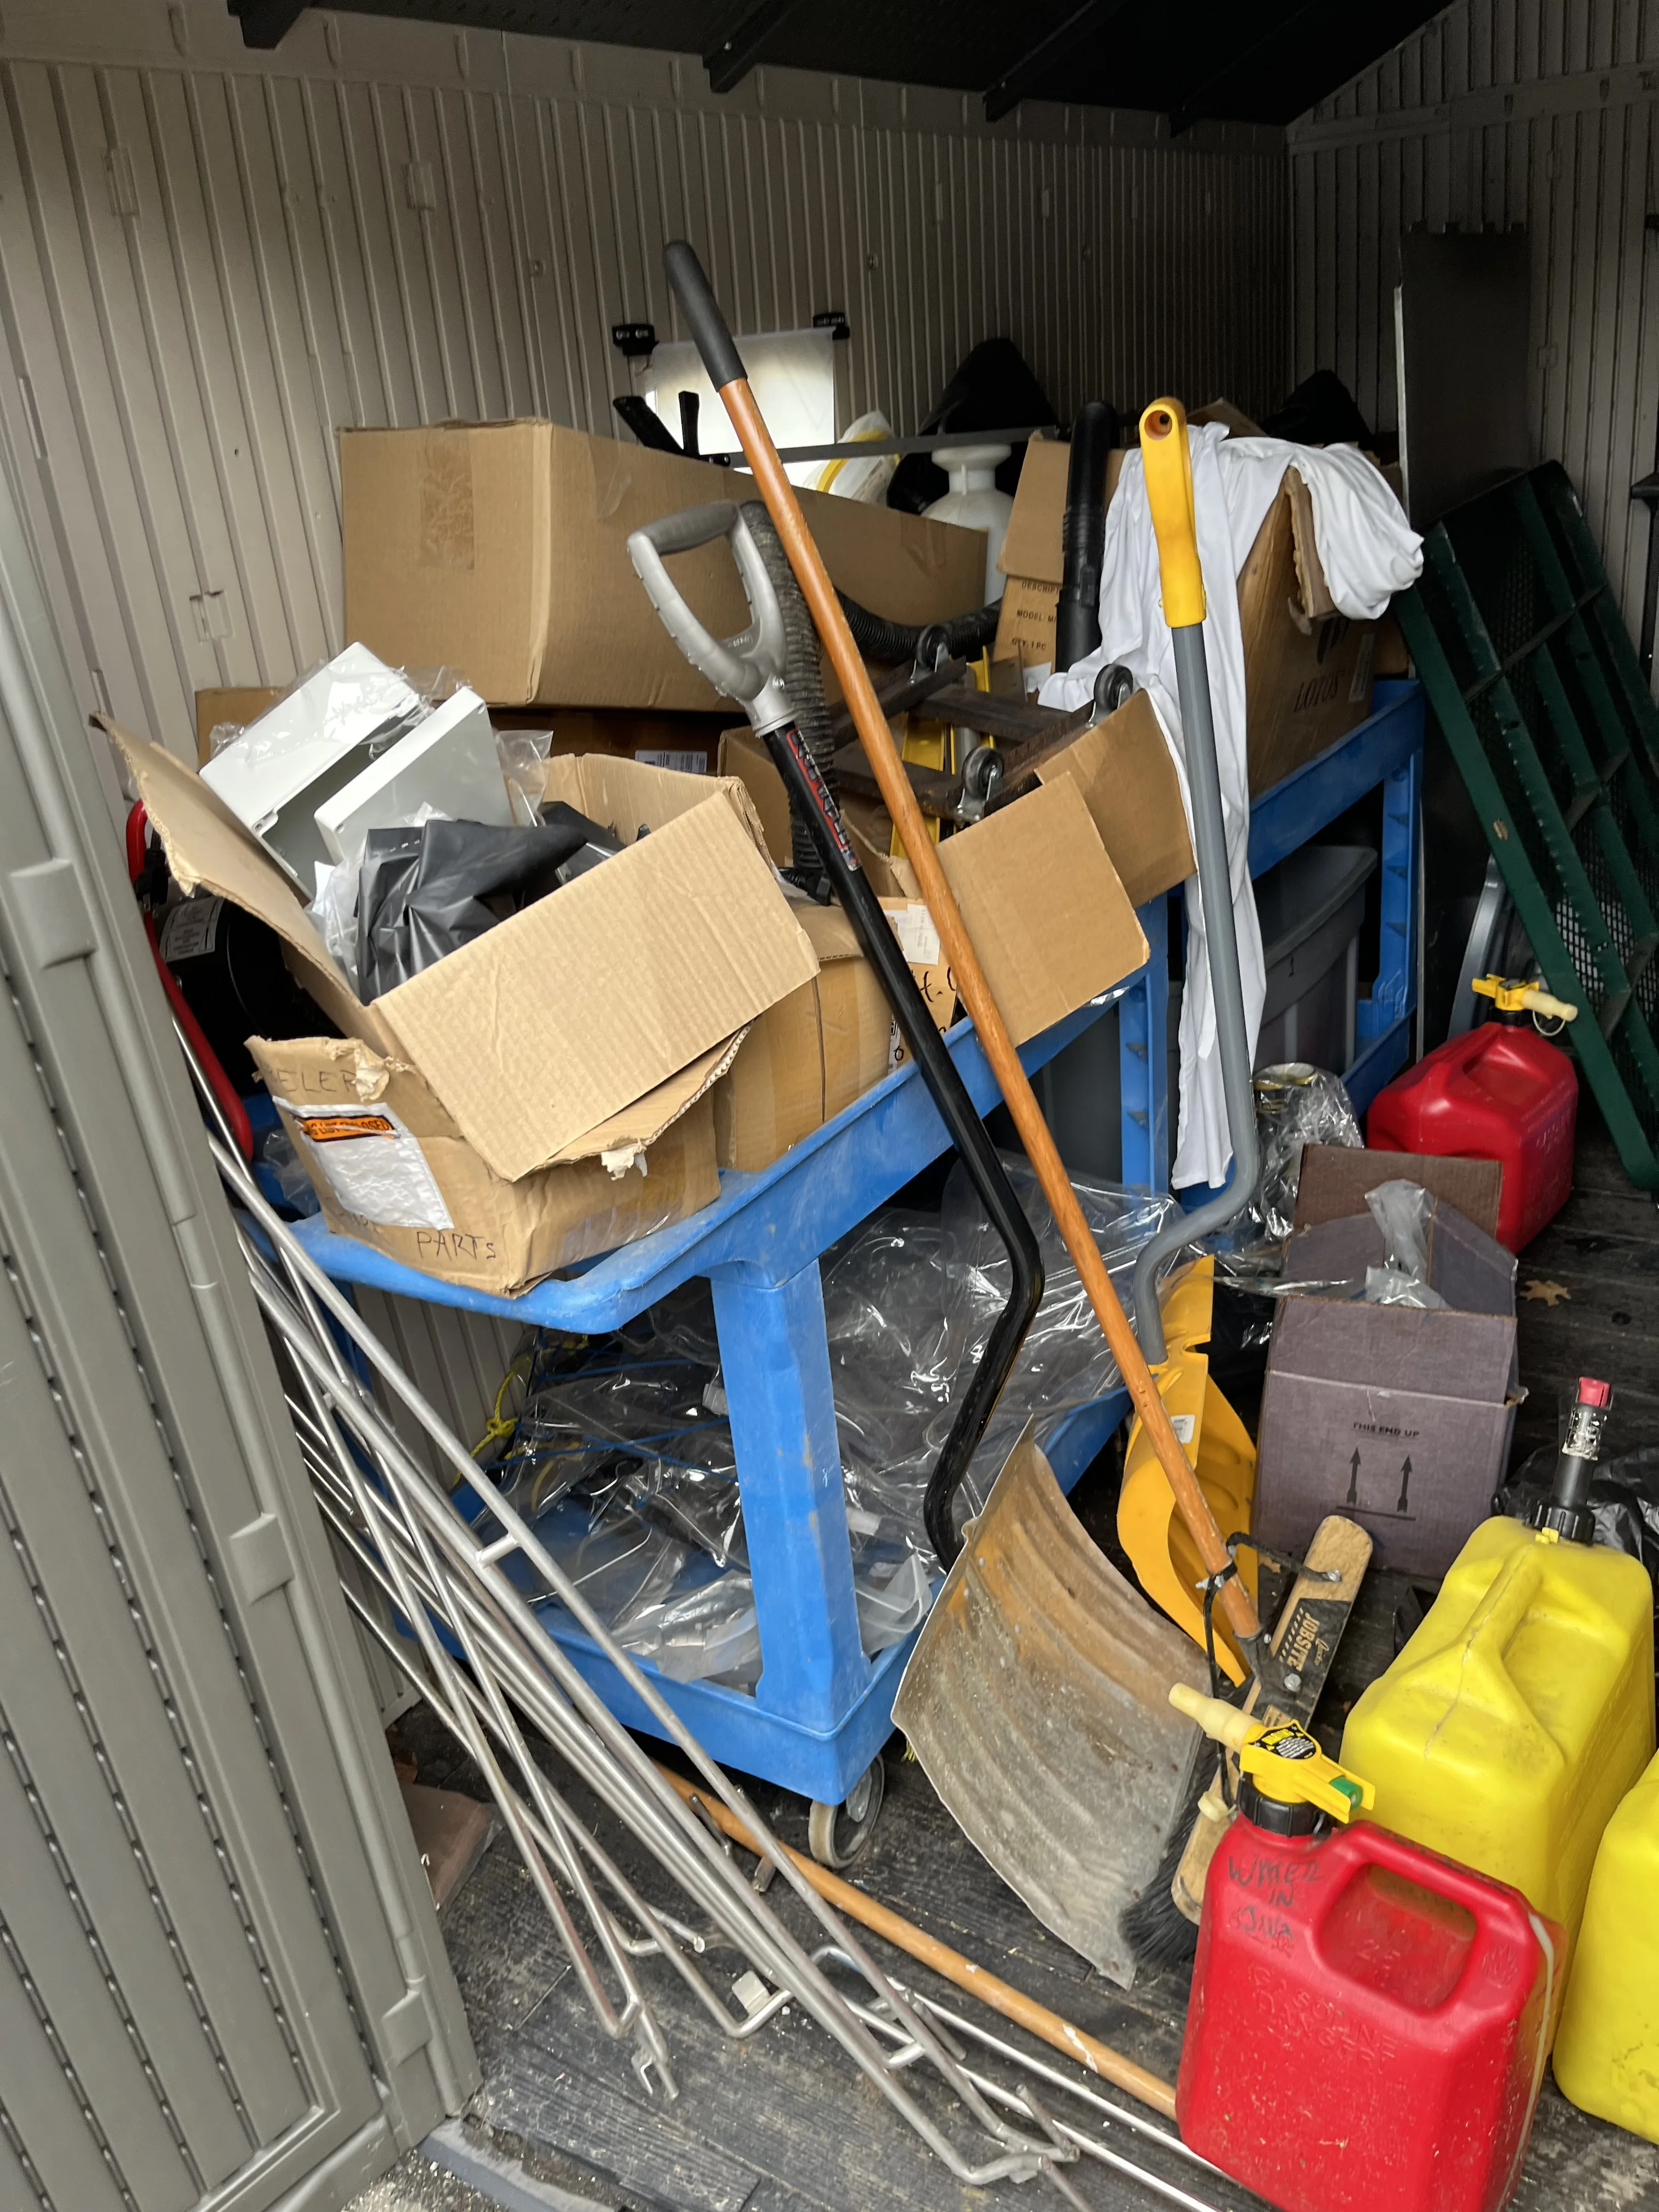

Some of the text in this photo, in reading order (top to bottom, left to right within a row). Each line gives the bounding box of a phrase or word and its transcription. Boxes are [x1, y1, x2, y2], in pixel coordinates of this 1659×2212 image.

[1353, 1421, 1419, 1438] THIS END UP
[1287, 1612, 1320, 1672] JOBSITE
